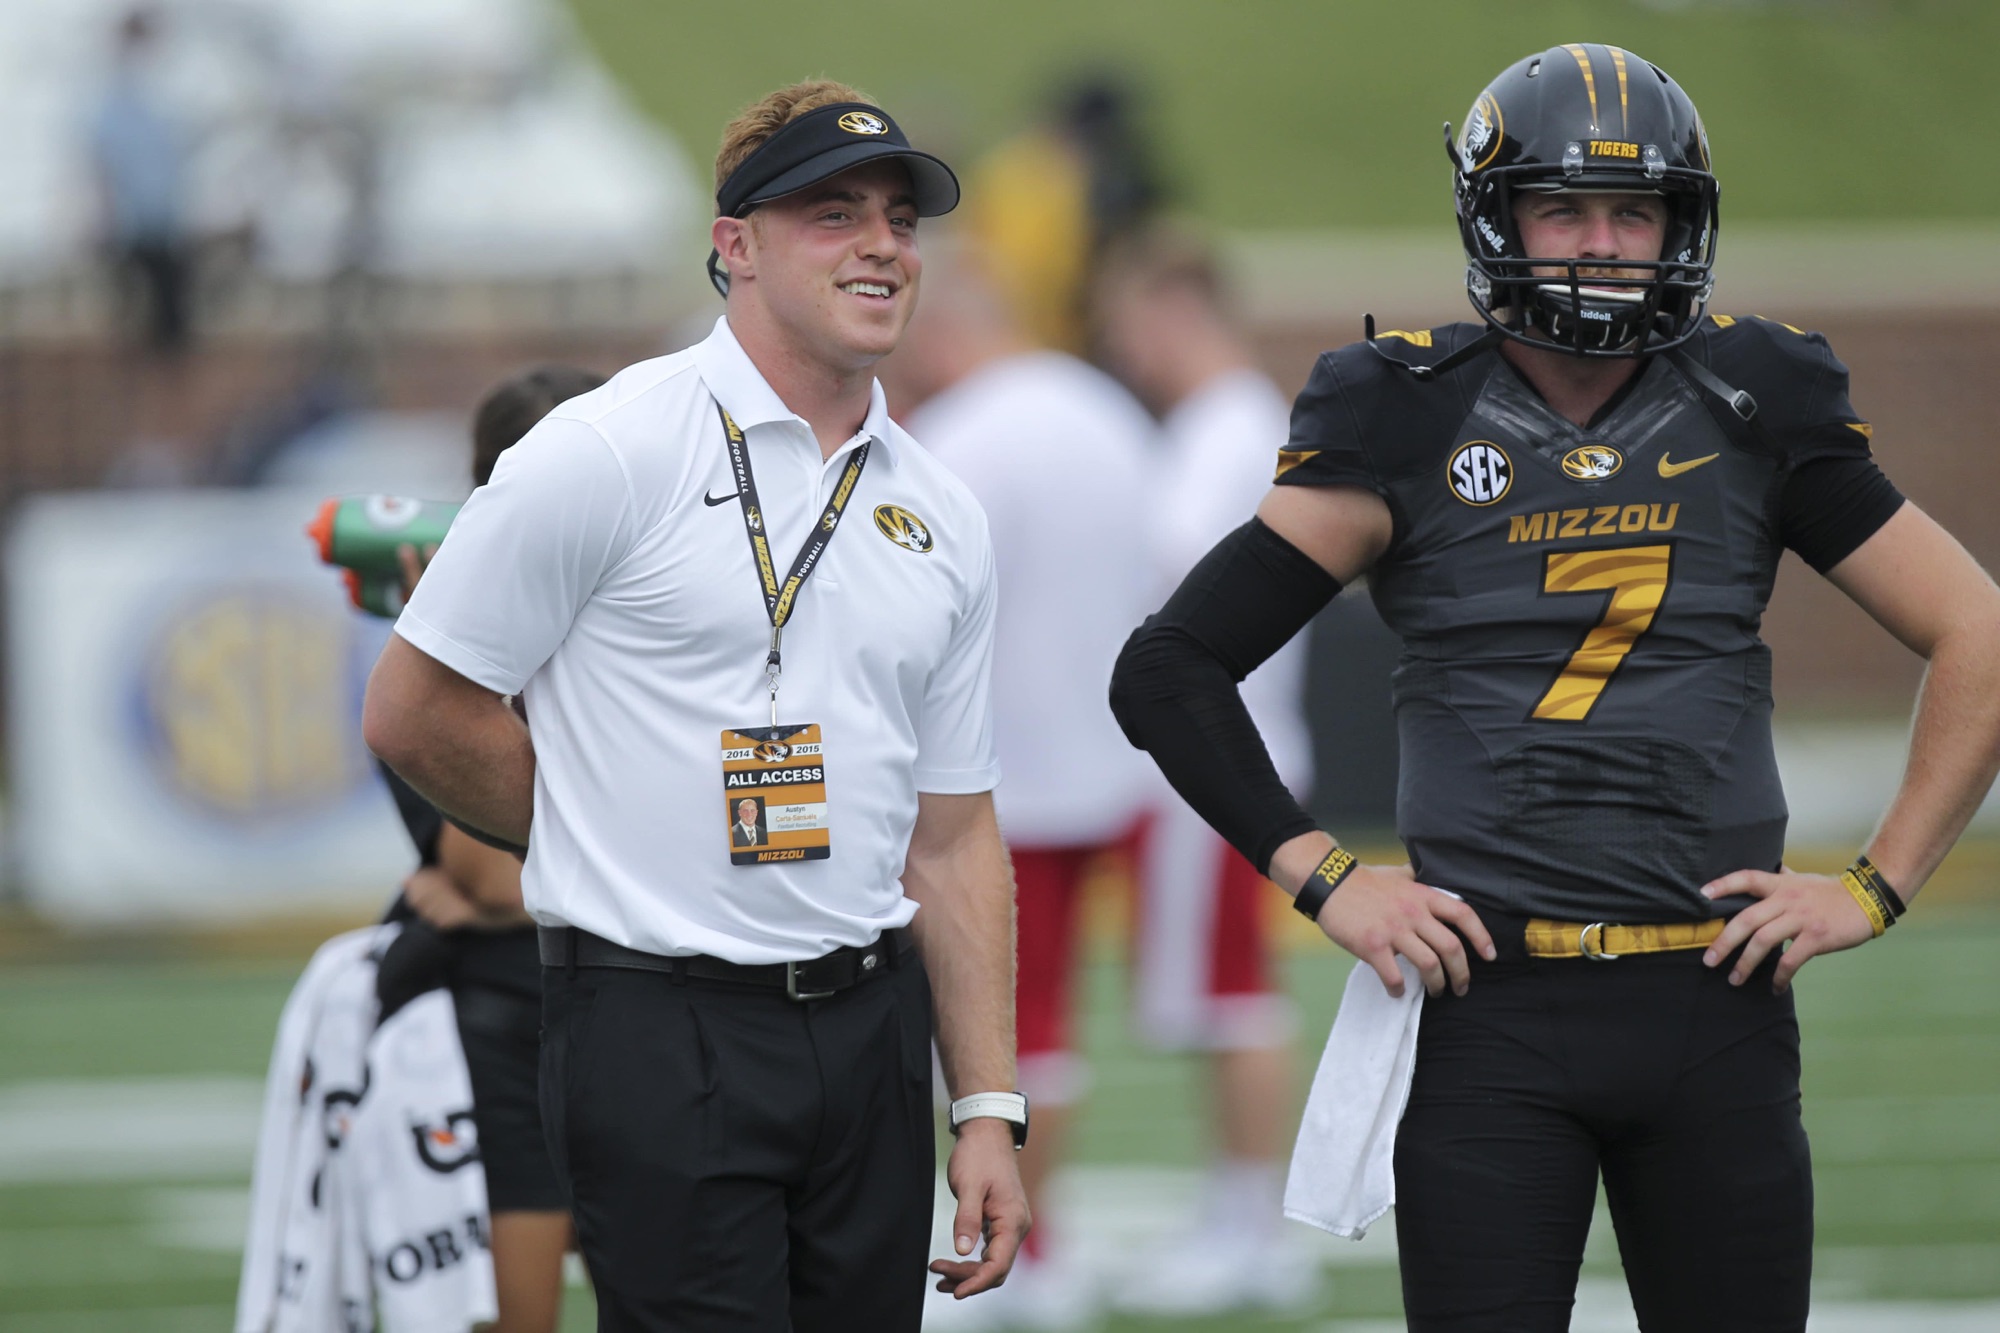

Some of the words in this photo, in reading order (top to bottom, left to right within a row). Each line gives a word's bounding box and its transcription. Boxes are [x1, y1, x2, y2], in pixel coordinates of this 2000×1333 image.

[1590, 140, 1638, 158] TIGERS
[1476, 215, 1505, 253] ddell.
[731, 442, 749, 494] FOOTBALL
[832, 461, 859, 512] MIZZOU
[1452, 446, 1507, 501] SEC
[1508, 503, 1680, 543] MIZZOU
[754, 535, 778, 596] MIZZOU
[797, 541, 823, 578] FOOTBALL
[1530, 544, 1671, 721] 7
[726, 749, 750, 759] 2014
[796, 743, 820, 754] 2015
[727, 772, 757, 787] ALL
[760, 767, 822, 784] ACCESS
[758, 850, 805, 862] MIZZOU
